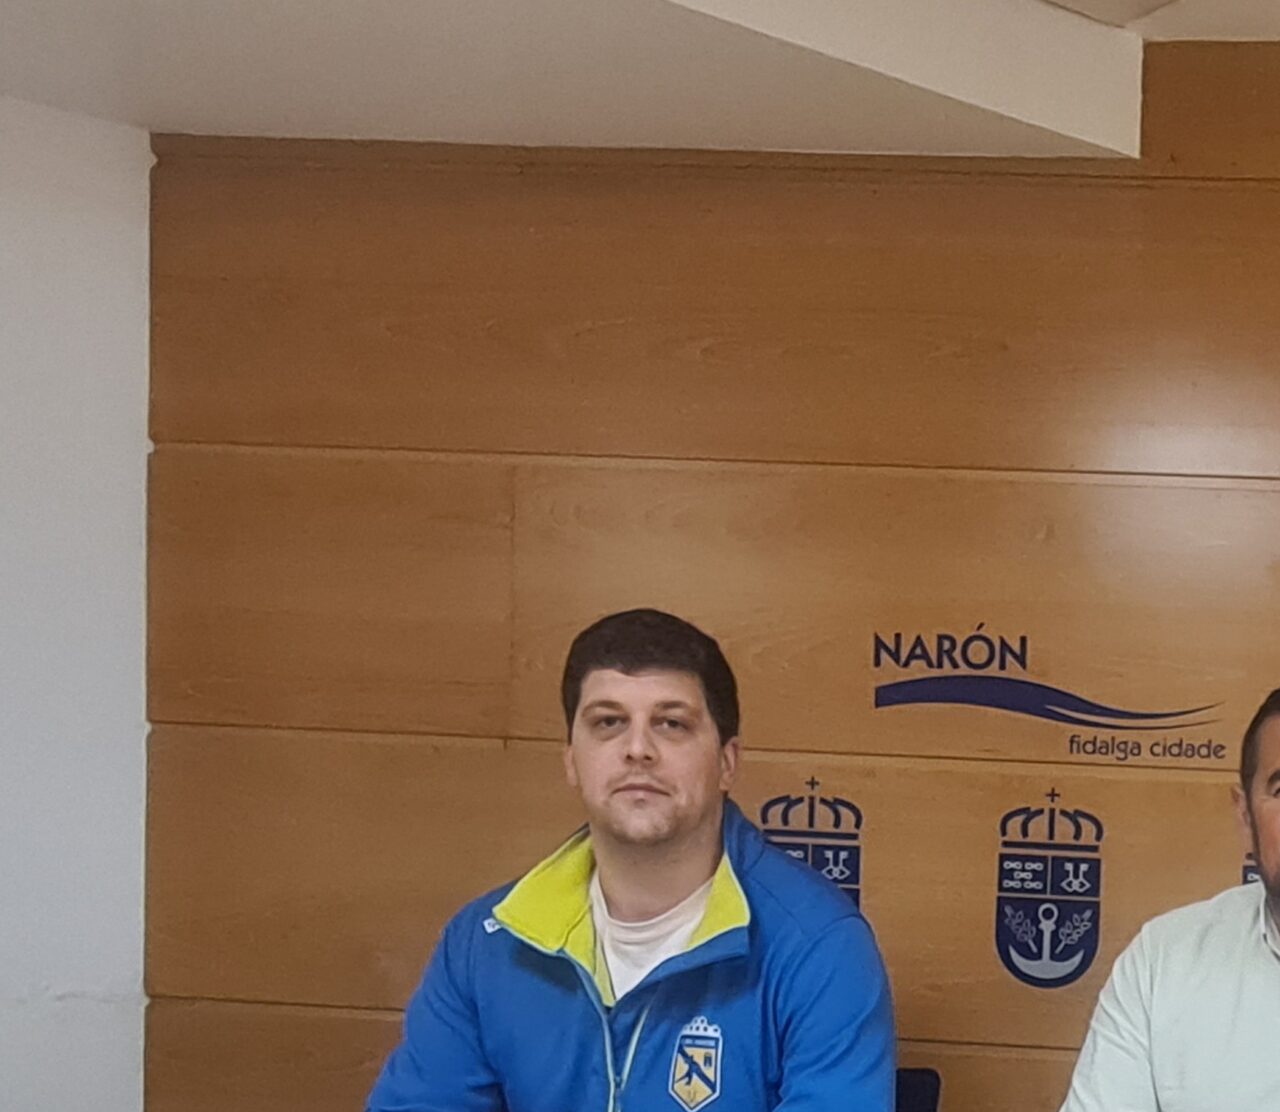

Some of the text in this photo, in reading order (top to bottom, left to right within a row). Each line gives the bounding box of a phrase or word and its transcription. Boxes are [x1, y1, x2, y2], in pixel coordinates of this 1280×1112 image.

[873, 622, 1028, 671] NARÓN
[1069, 735, 1226, 761] fidalga cidade
